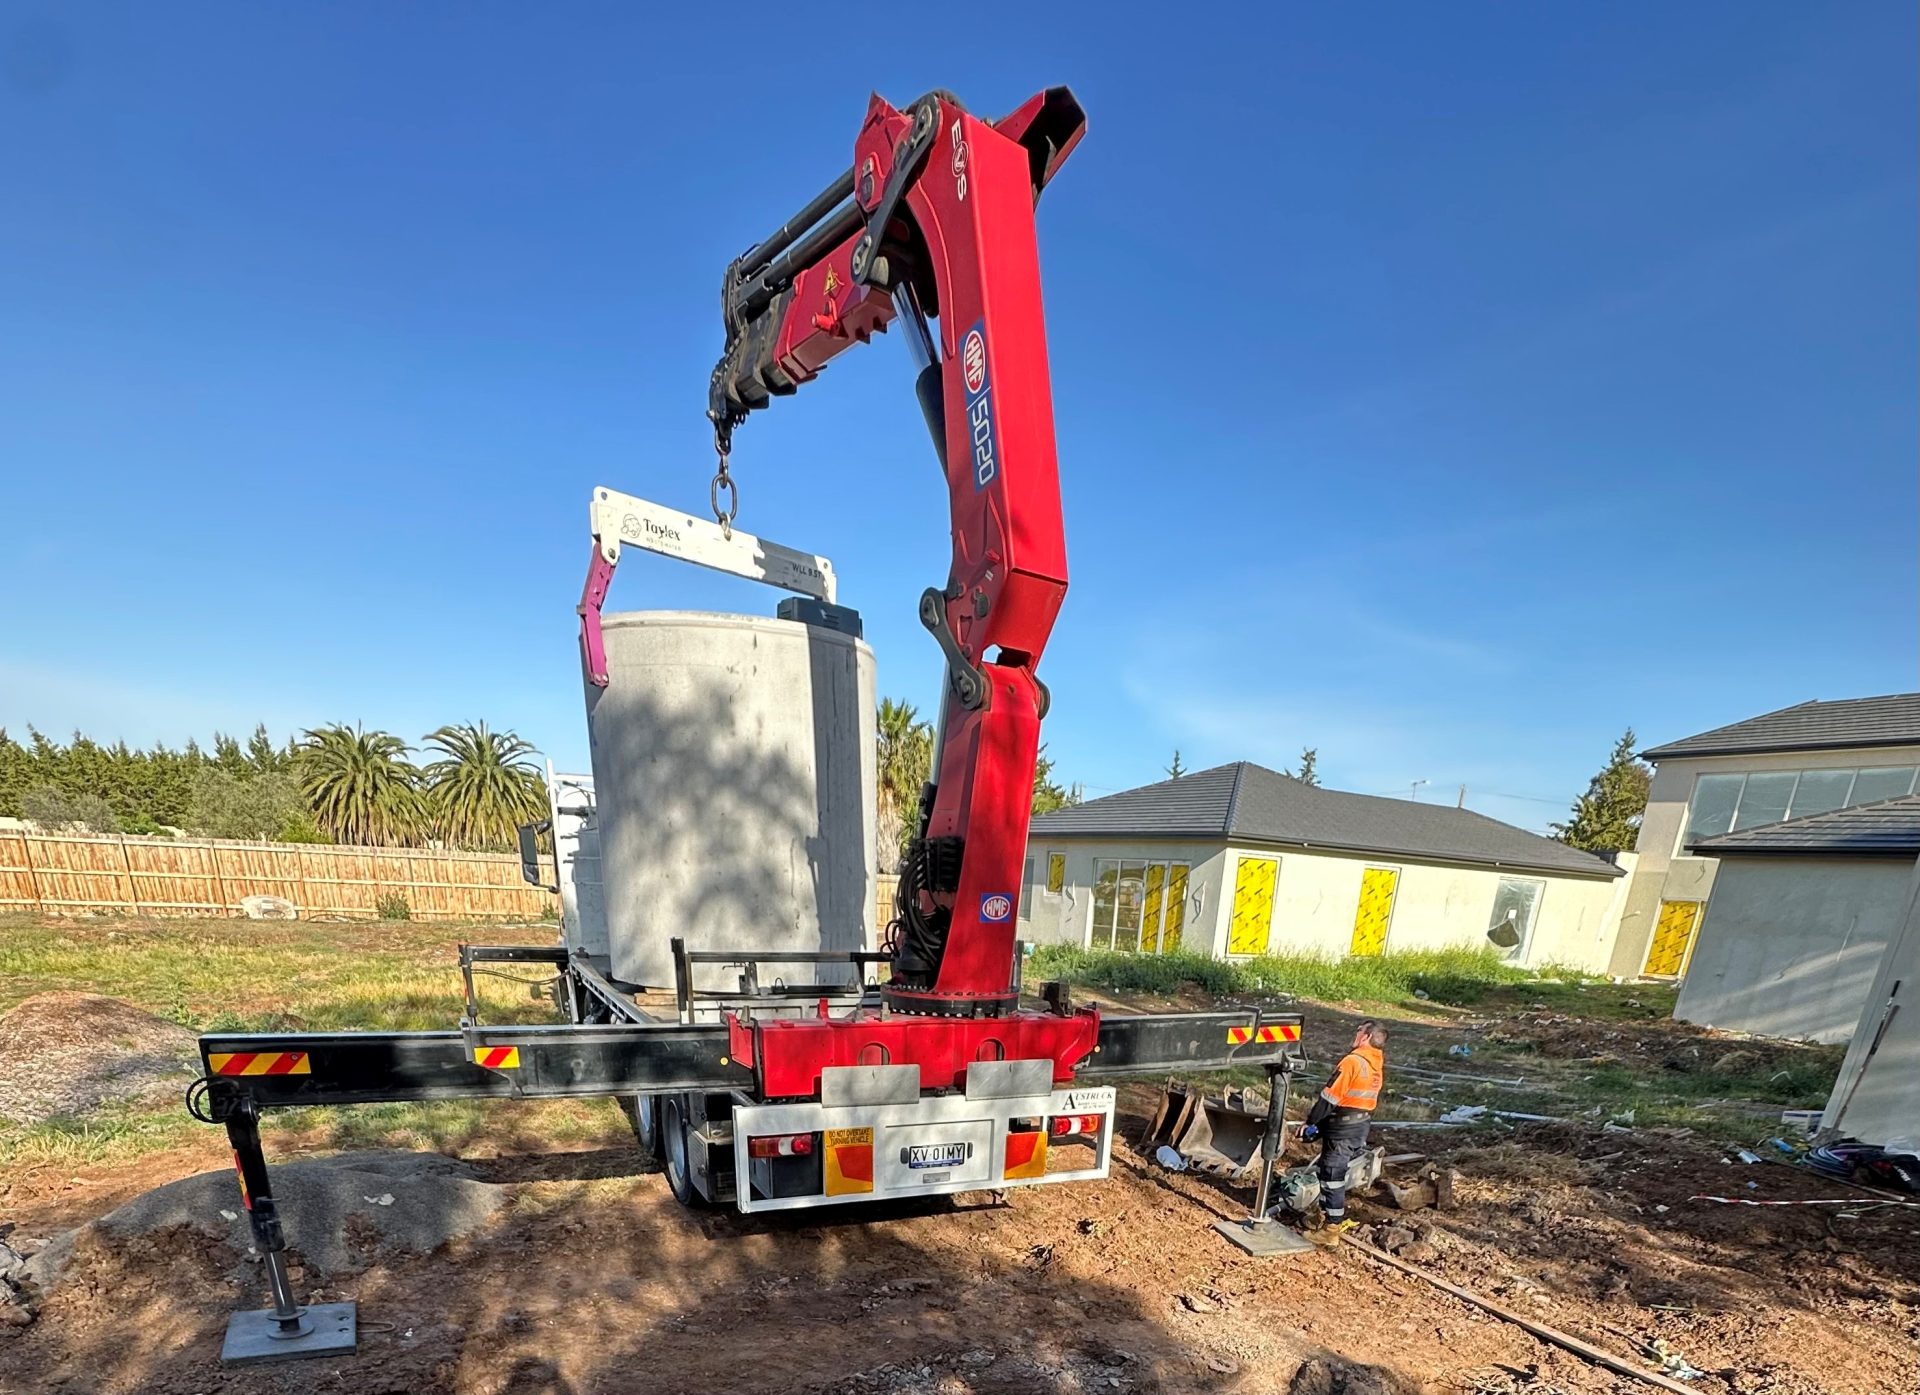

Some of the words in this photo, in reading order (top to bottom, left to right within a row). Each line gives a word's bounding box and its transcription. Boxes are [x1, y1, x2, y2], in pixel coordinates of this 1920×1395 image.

[966, 337, 983, 384] HMF
[972, 397, 995, 486] 5020
[643, 518, 681, 541] Taylex
[986, 899, 1007, 917] HMF
